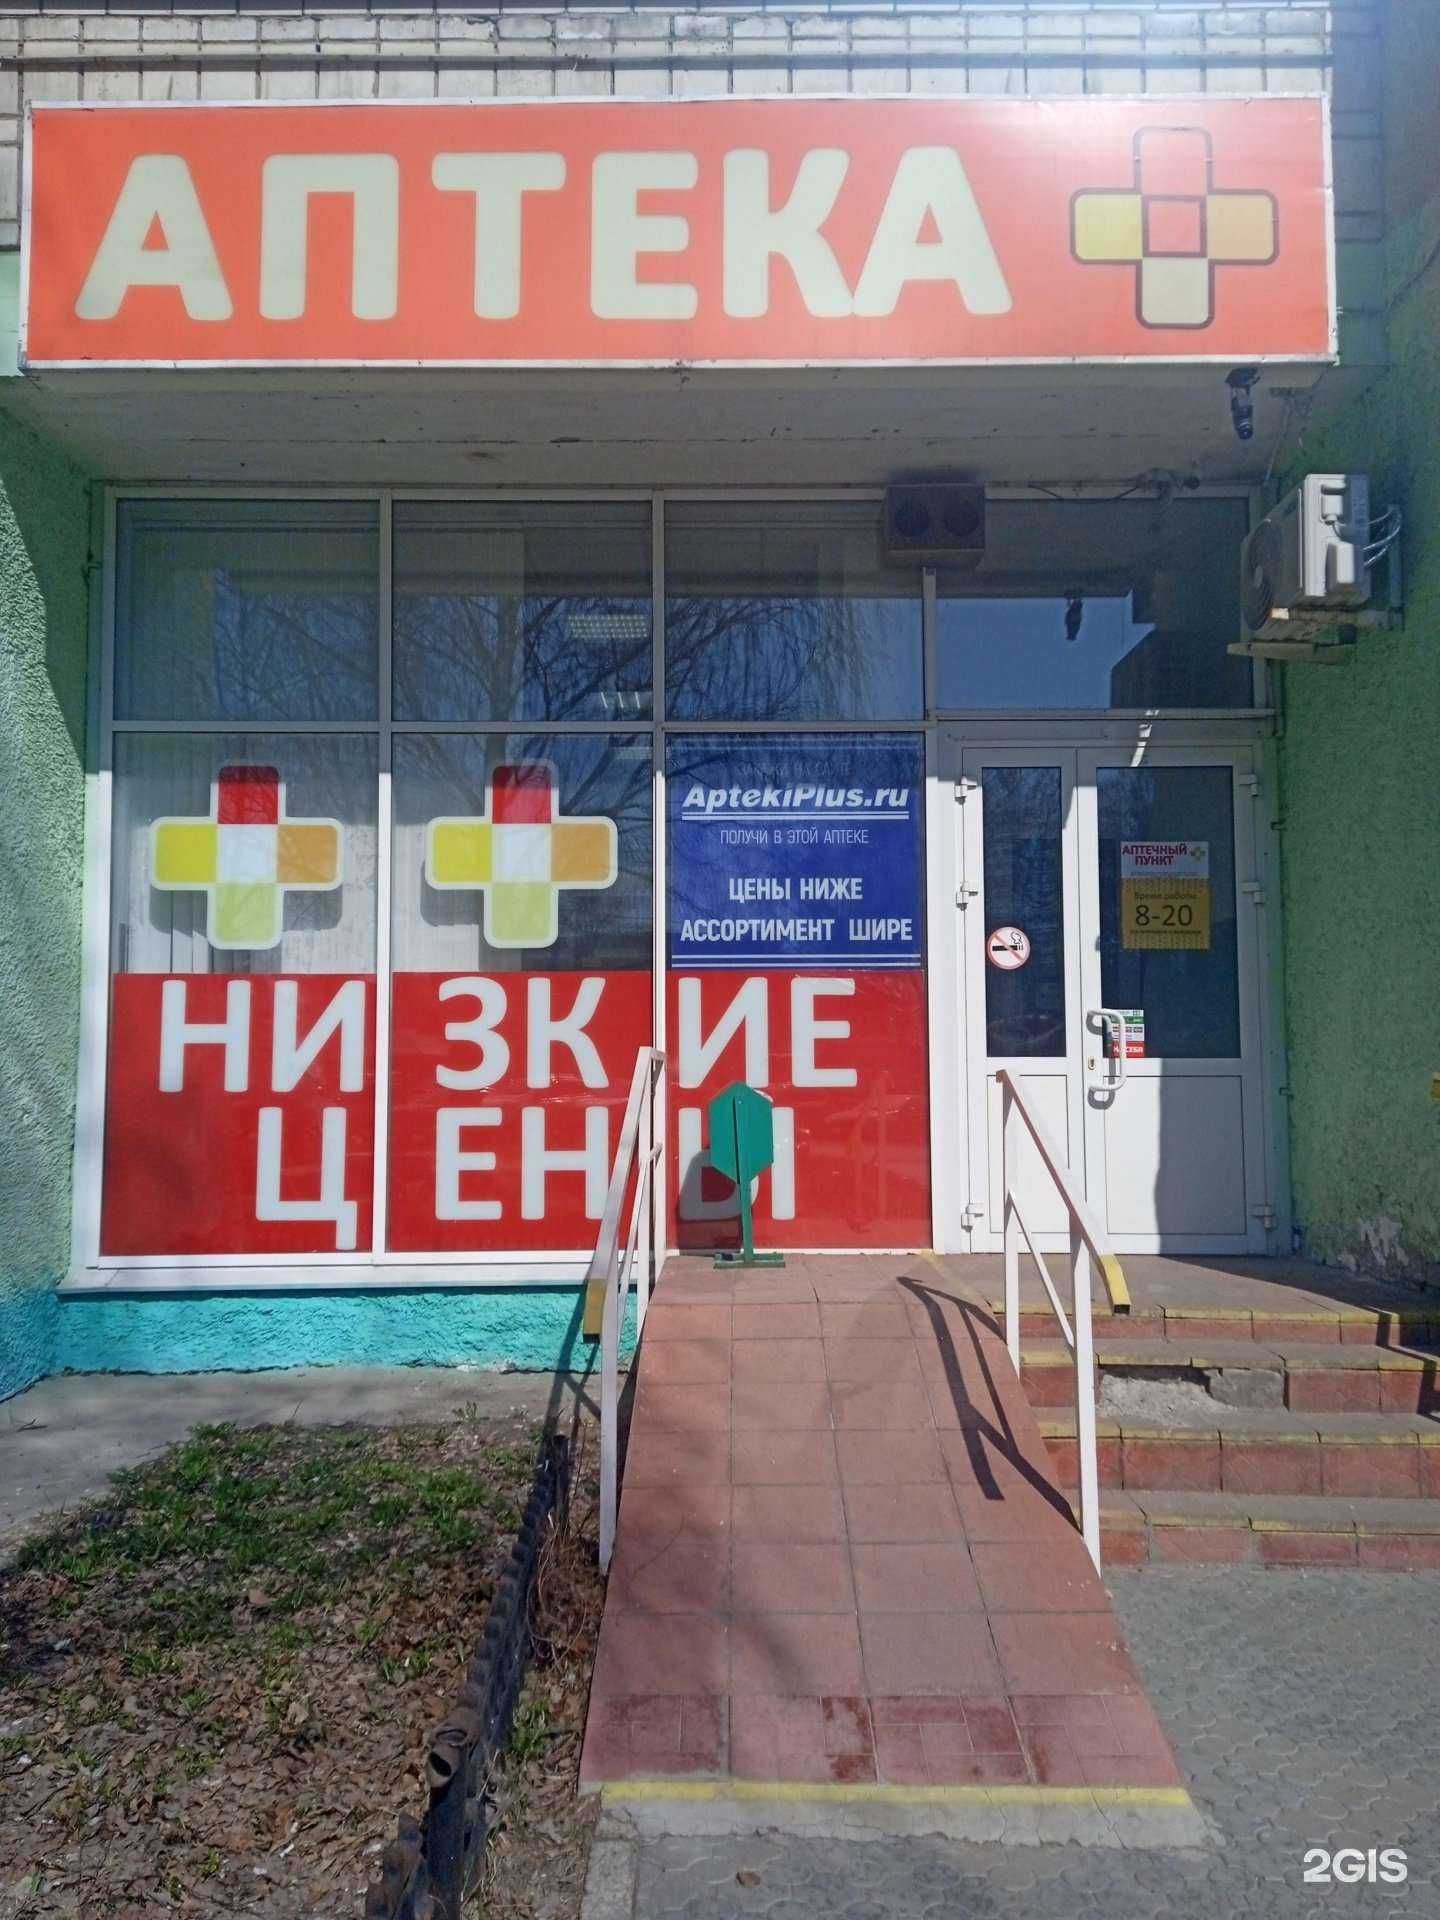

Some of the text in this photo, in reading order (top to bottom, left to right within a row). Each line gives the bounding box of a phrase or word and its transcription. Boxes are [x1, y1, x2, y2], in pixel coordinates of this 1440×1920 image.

[75, 146, 1013, 322] АПТЕКА
[682, 782, 910, 815] AptekiPlus.ru
[720, 826, 869, 844] ПОЛУЧИ В ЭТОЙ АПТЕКЕ
[1122, 843, 1188, 856] АПТЕЧНЫЙ
[1135, 855, 1175, 866] ПУНКТ
[729, 877, 863, 903] ЦЕНЫ НИЖЕ
[1135, 904, 1193, 927] 8-20
[680, 918, 913, 942] АССОРТИМЕНТ ШИРЕ
[158, 976, 857, 1093] НИЗКИЕ
